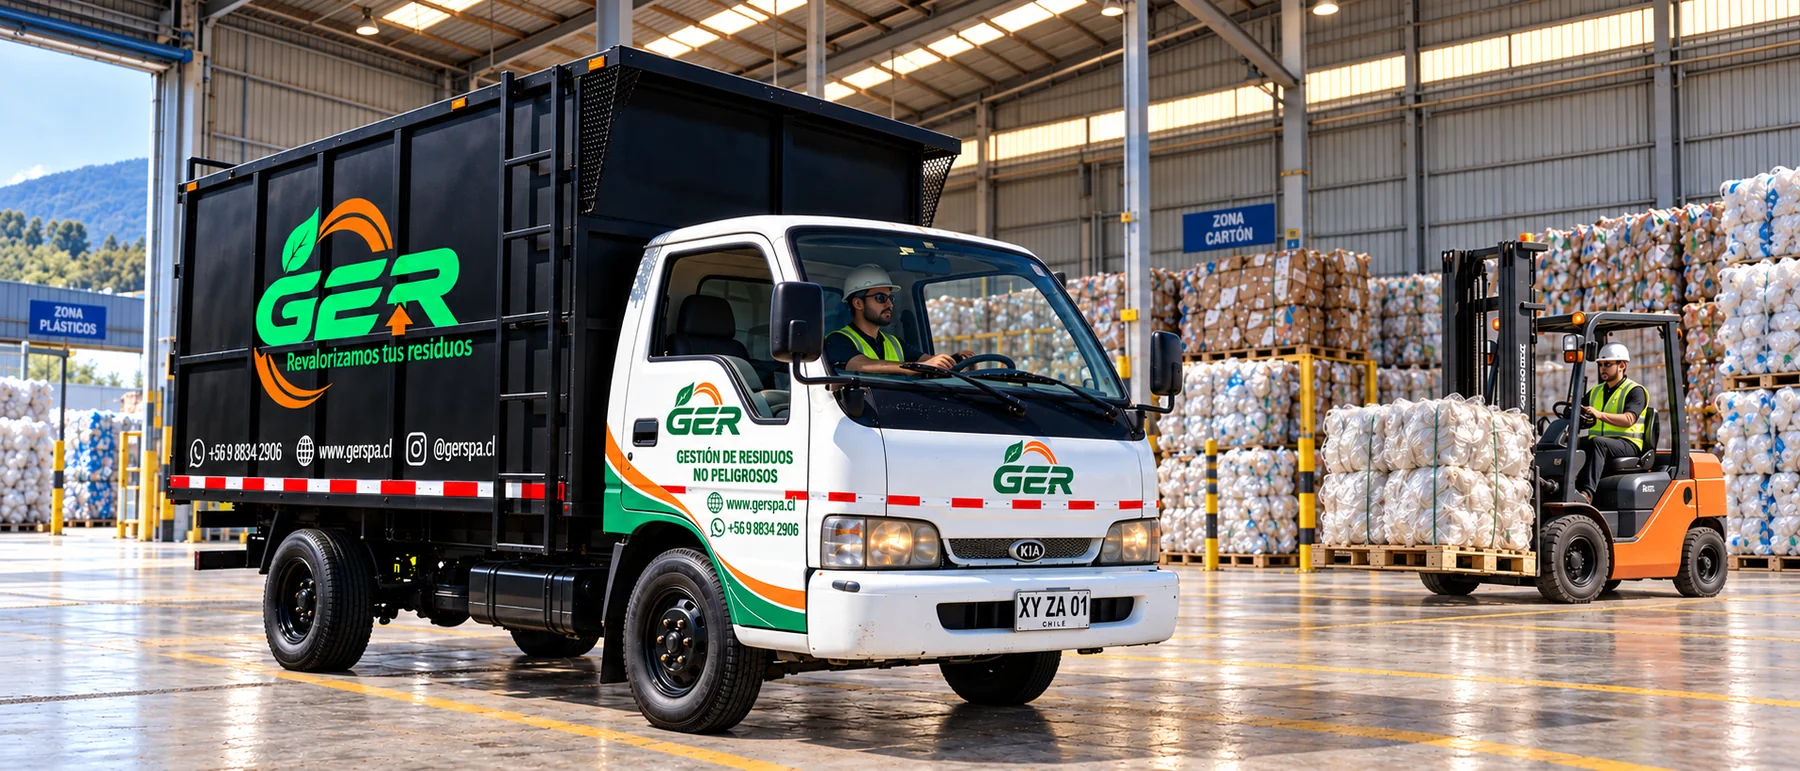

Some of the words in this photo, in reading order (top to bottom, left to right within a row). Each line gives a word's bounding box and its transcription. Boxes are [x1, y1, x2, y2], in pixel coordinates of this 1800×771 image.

[1213, 212, 1244, 228] ZONA
[1205, 226, 1253, 245] CARTÓN
[255, 247, 460, 346] GER
[54, 305, 83, 319] ZONA
[40, 319, 97, 335] PLÁSTICOS
[286, 348, 379, 371] Revalorizamos
[382, 344, 403, 363] tus
[408, 336, 473, 362] residuos
[666, 406, 742, 435] GER
[208, 443, 225, 461] +56
[227, 443, 233, 461] 9
[234, 443, 257, 461] 8834
[258, 442, 282, 461] 2906
[319, 438, 392, 463] www.gerspa.cl
[433, 435, 496, 462] @gerspa.cl
[676, 446, 720, 464] GESTIÓN
[723, 450, 737, 464] DE
[739, 450, 793, 464] RESIDUOS
[693, 468, 708, 482] NO
[711, 468, 778, 483] PELIGROSOS
[993, 465, 1074, 495] GER
[726, 496, 796, 514] www.gerspa.cl
[728, 521, 745, 535] +56
[746, 521, 752, 535] 9
[753, 521, 775, 536] 8834
[776, 522, 799, 536] 2906
[1020, 545, 1040, 557] KIA
[1019, 596, 1042, 618] XY
[1046, 595, 1066, 618] ZA
[1071, 595, 1087, 617] 01
[1042, 620, 1066, 628] CHILE
